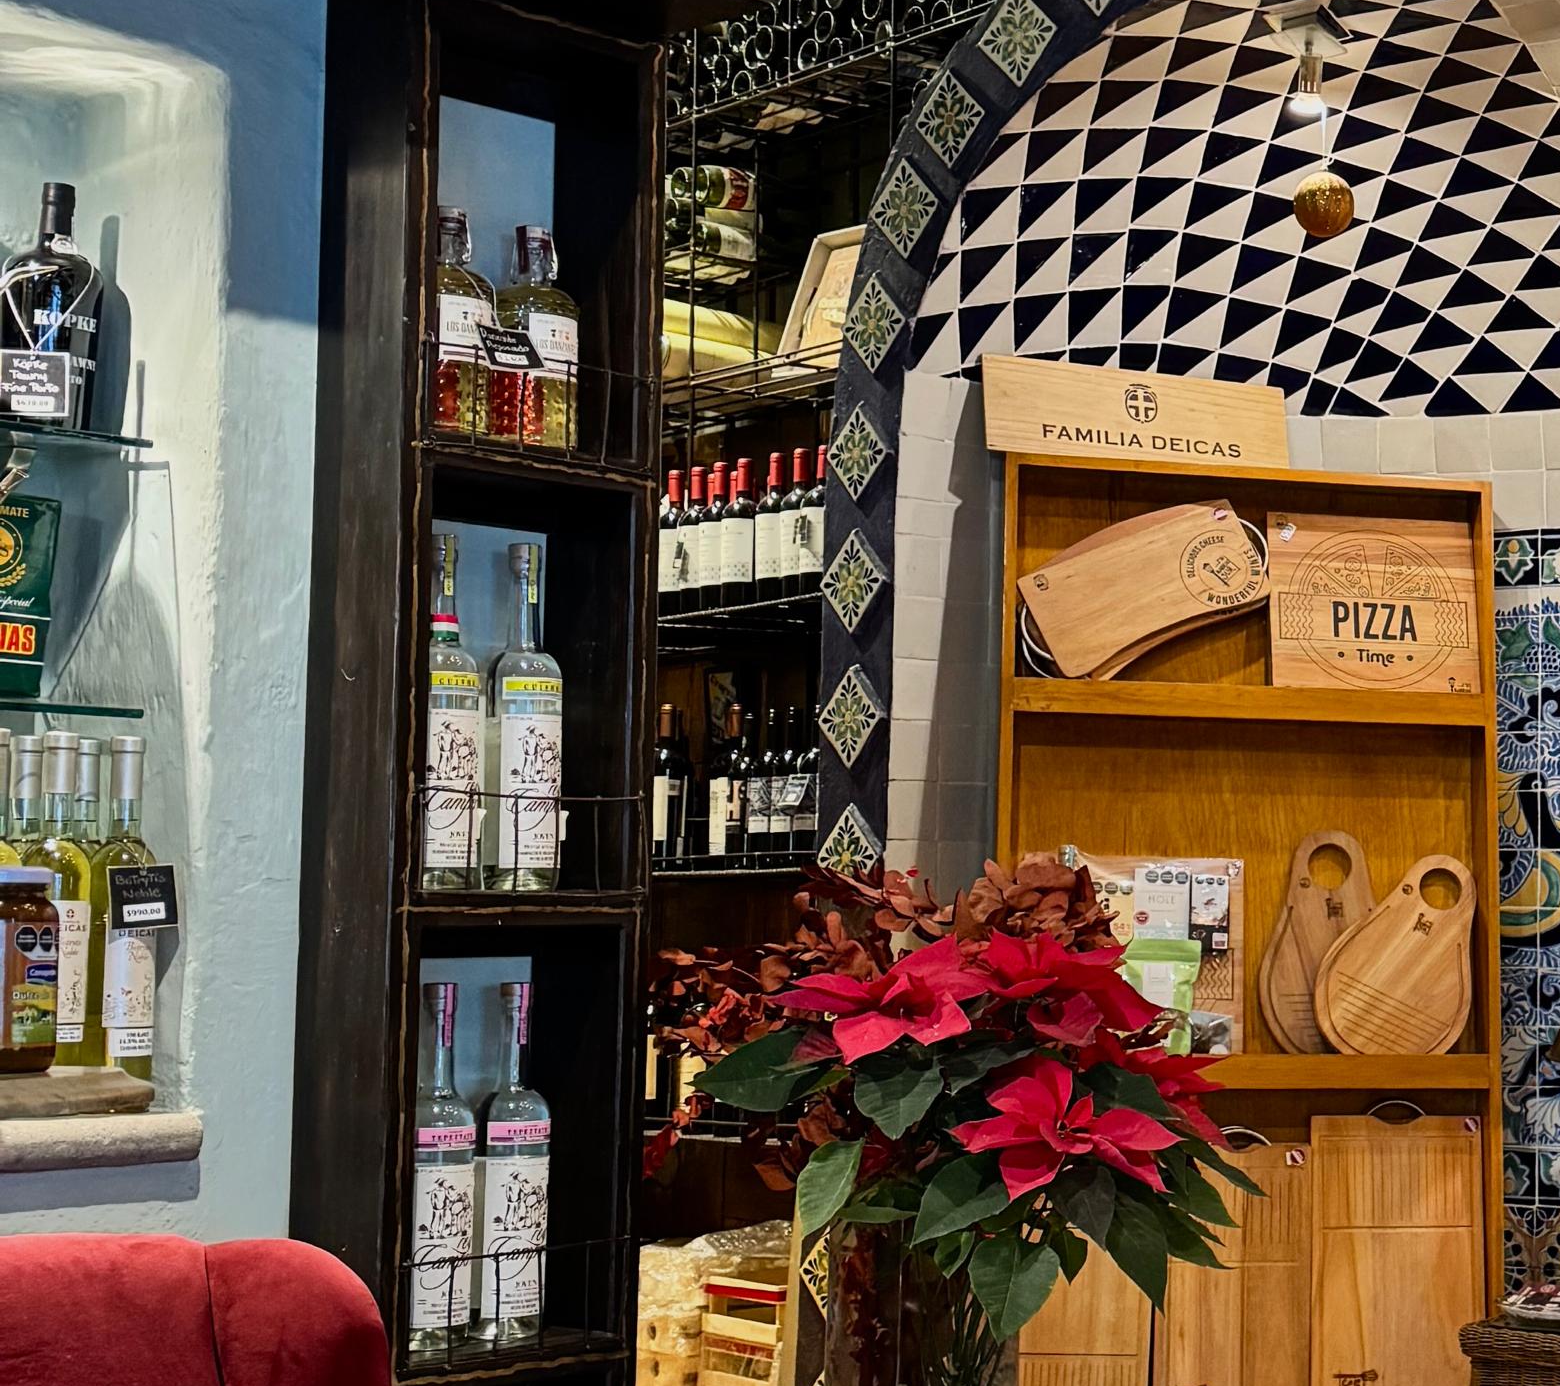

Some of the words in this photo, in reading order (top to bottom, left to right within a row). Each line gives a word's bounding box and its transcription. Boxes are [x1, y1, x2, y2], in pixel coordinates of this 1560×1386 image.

[33, 308, 97, 333] KOPKE
[1042, 423, 1144, 449] FAMILIA
[1151, 435, 1242, 458] DEICAS
[1199, 535, 1225, 550] CHEESE
[1207, 580, 1259, 606] WONDERFUL
[1243, 548, 1261, 577] WINES
[1331, 600, 1418, 642] PIZZA
[1356, 648, 1396, 667] Time
[118, 929, 156, 938] DEICA
